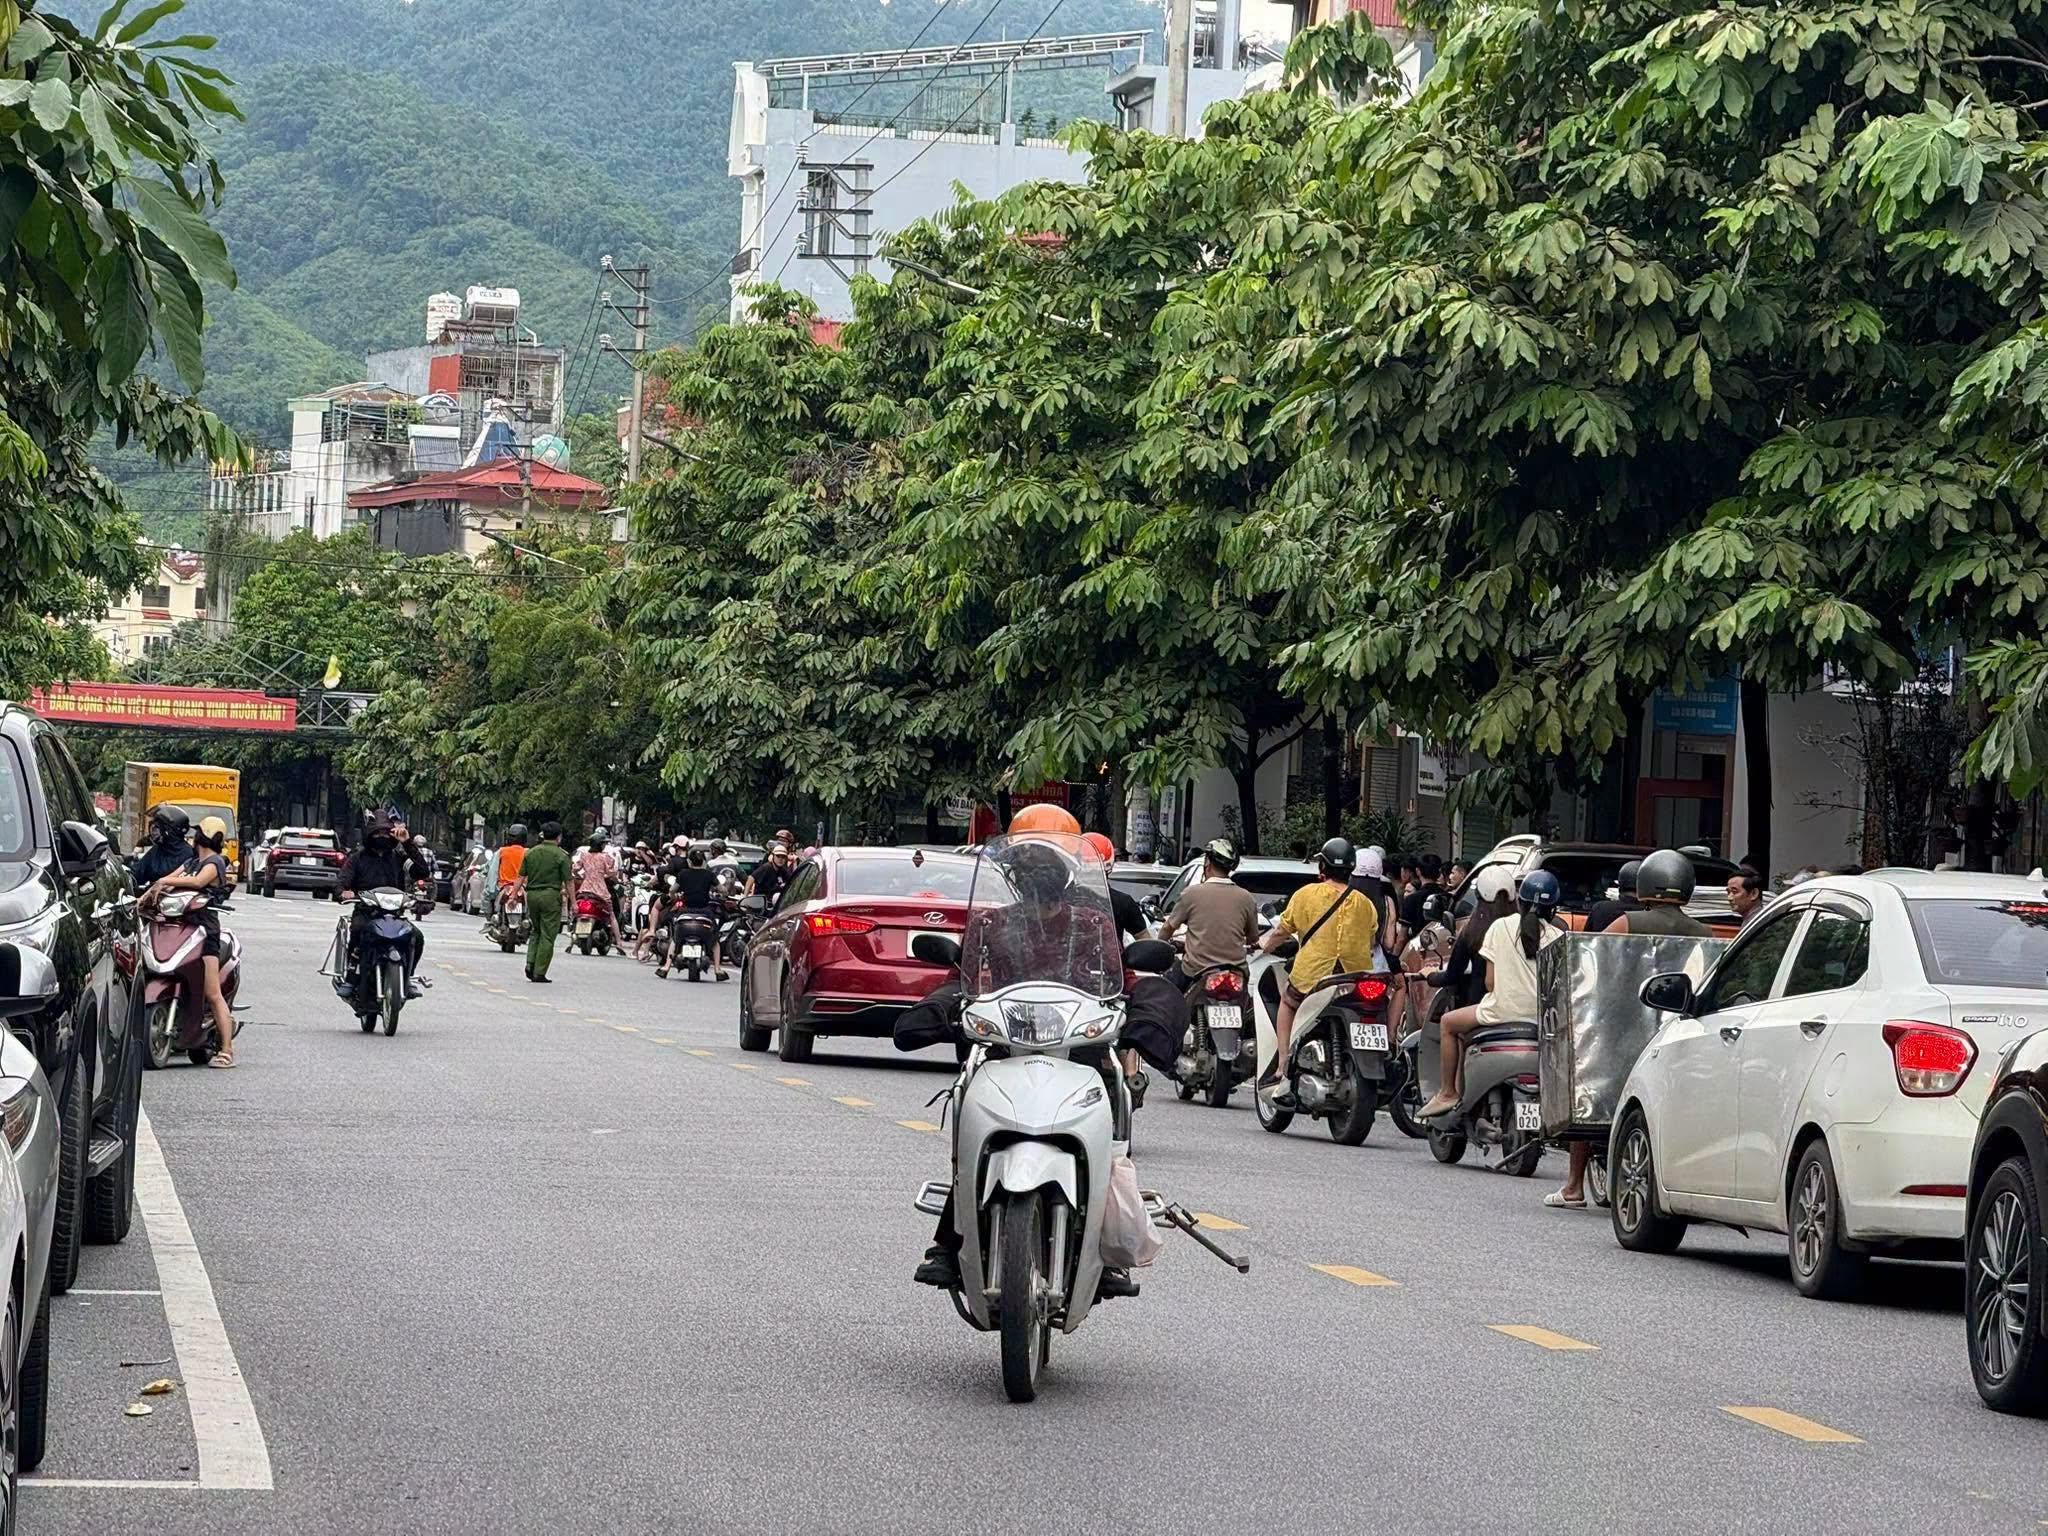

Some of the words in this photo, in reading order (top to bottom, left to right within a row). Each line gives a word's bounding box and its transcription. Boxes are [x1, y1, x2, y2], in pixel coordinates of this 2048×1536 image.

[49, 687, 75, 711] ĐẢNG
[77, 692, 103, 716] CỘNG
[105, 690, 125, 714] SẢN
[127, 694, 147, 718] VIỆT
[149, 698, 171, 716] NAM
[172, 700, 205, 718] QUANG
[206, 701, 229, 718] VINH
[229, 700, 258, 720] MUÔN
[1999, 1013, 2028, 1028] i10
[1357, 1024, 1382, 1037] 24-B1
[1354, 1036, 1386, 1048] 582.99
[1024, 1059, 1055, 1067] HONDA
